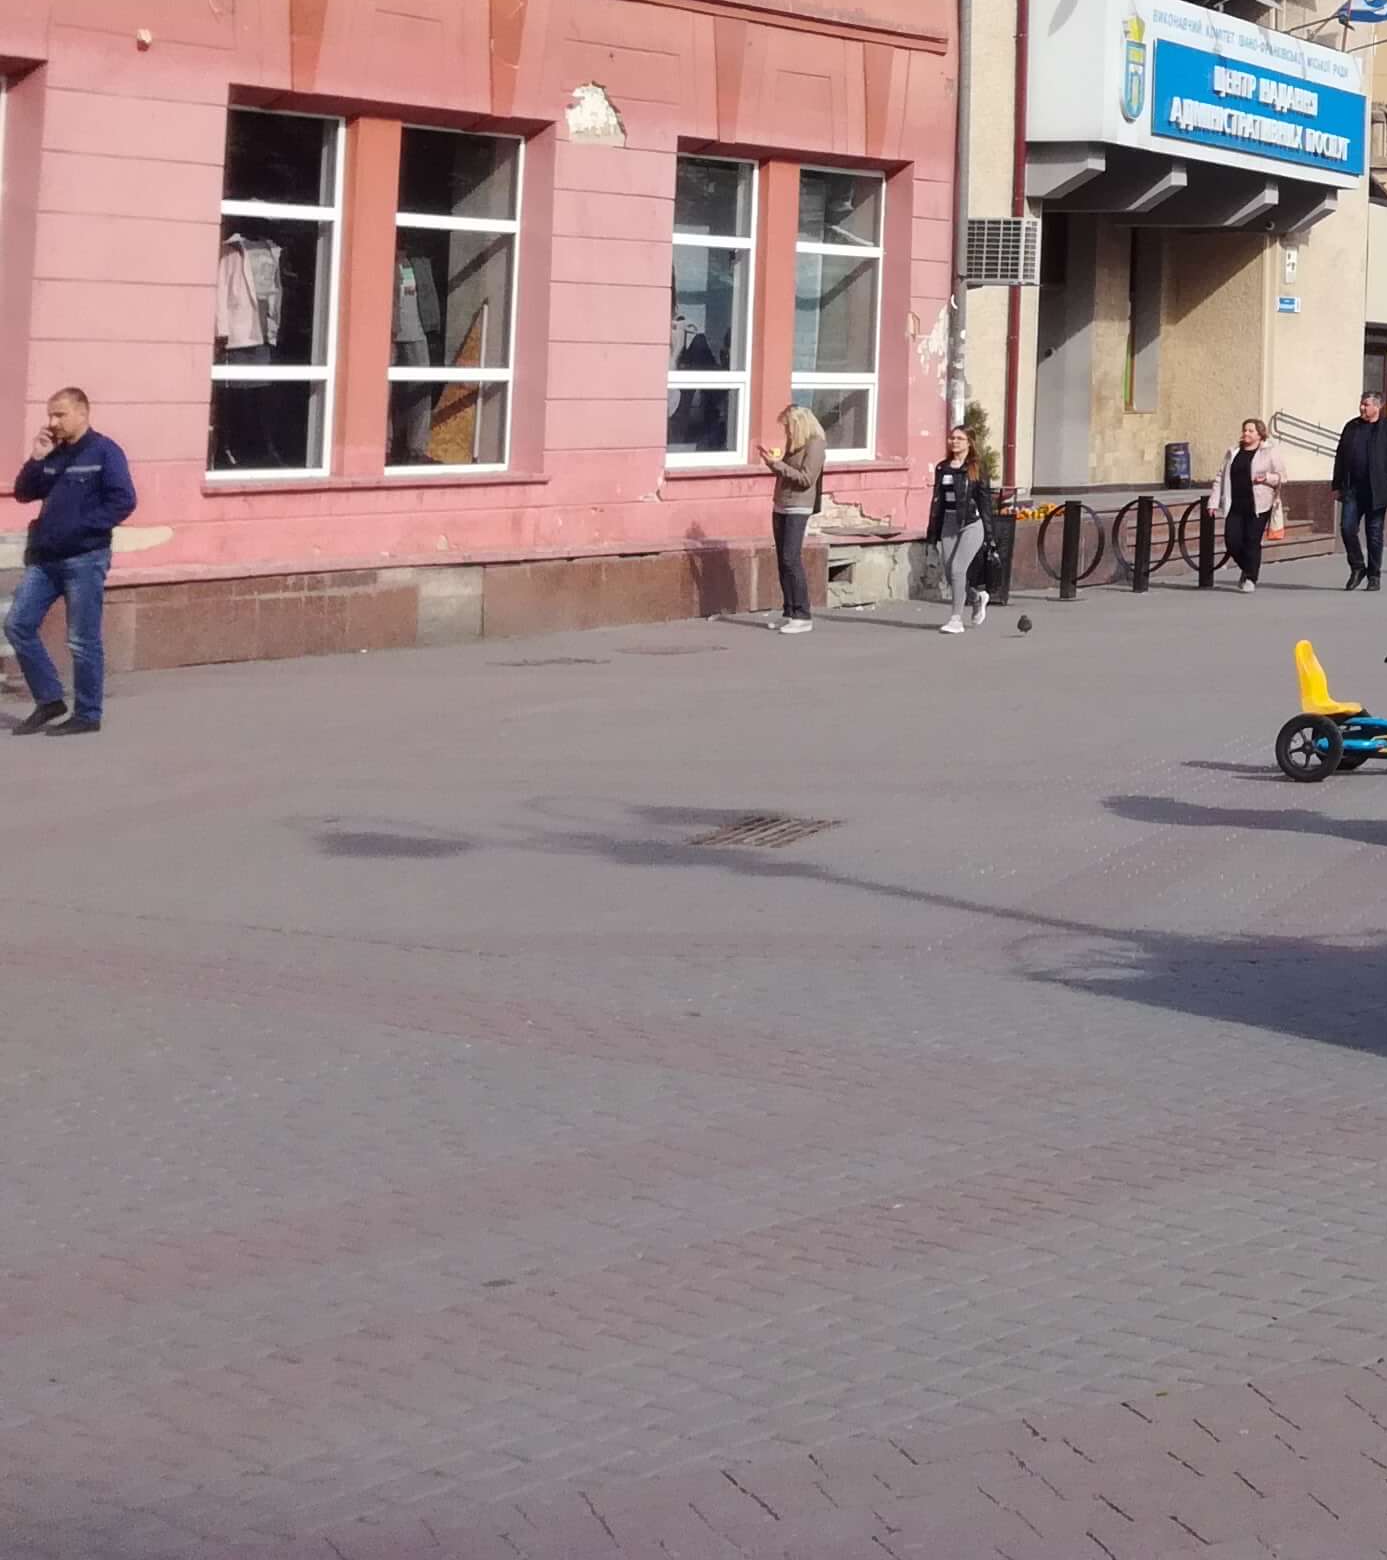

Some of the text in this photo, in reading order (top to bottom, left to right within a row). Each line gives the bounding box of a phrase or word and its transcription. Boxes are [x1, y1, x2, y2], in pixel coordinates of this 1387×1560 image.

[1214, 65, 1318, 117] ЦЕНТР НАДАННЯ
[1168, 96, 1351, 161] АДМІНІСТРАТИВНИХ ПОСЛУГ
